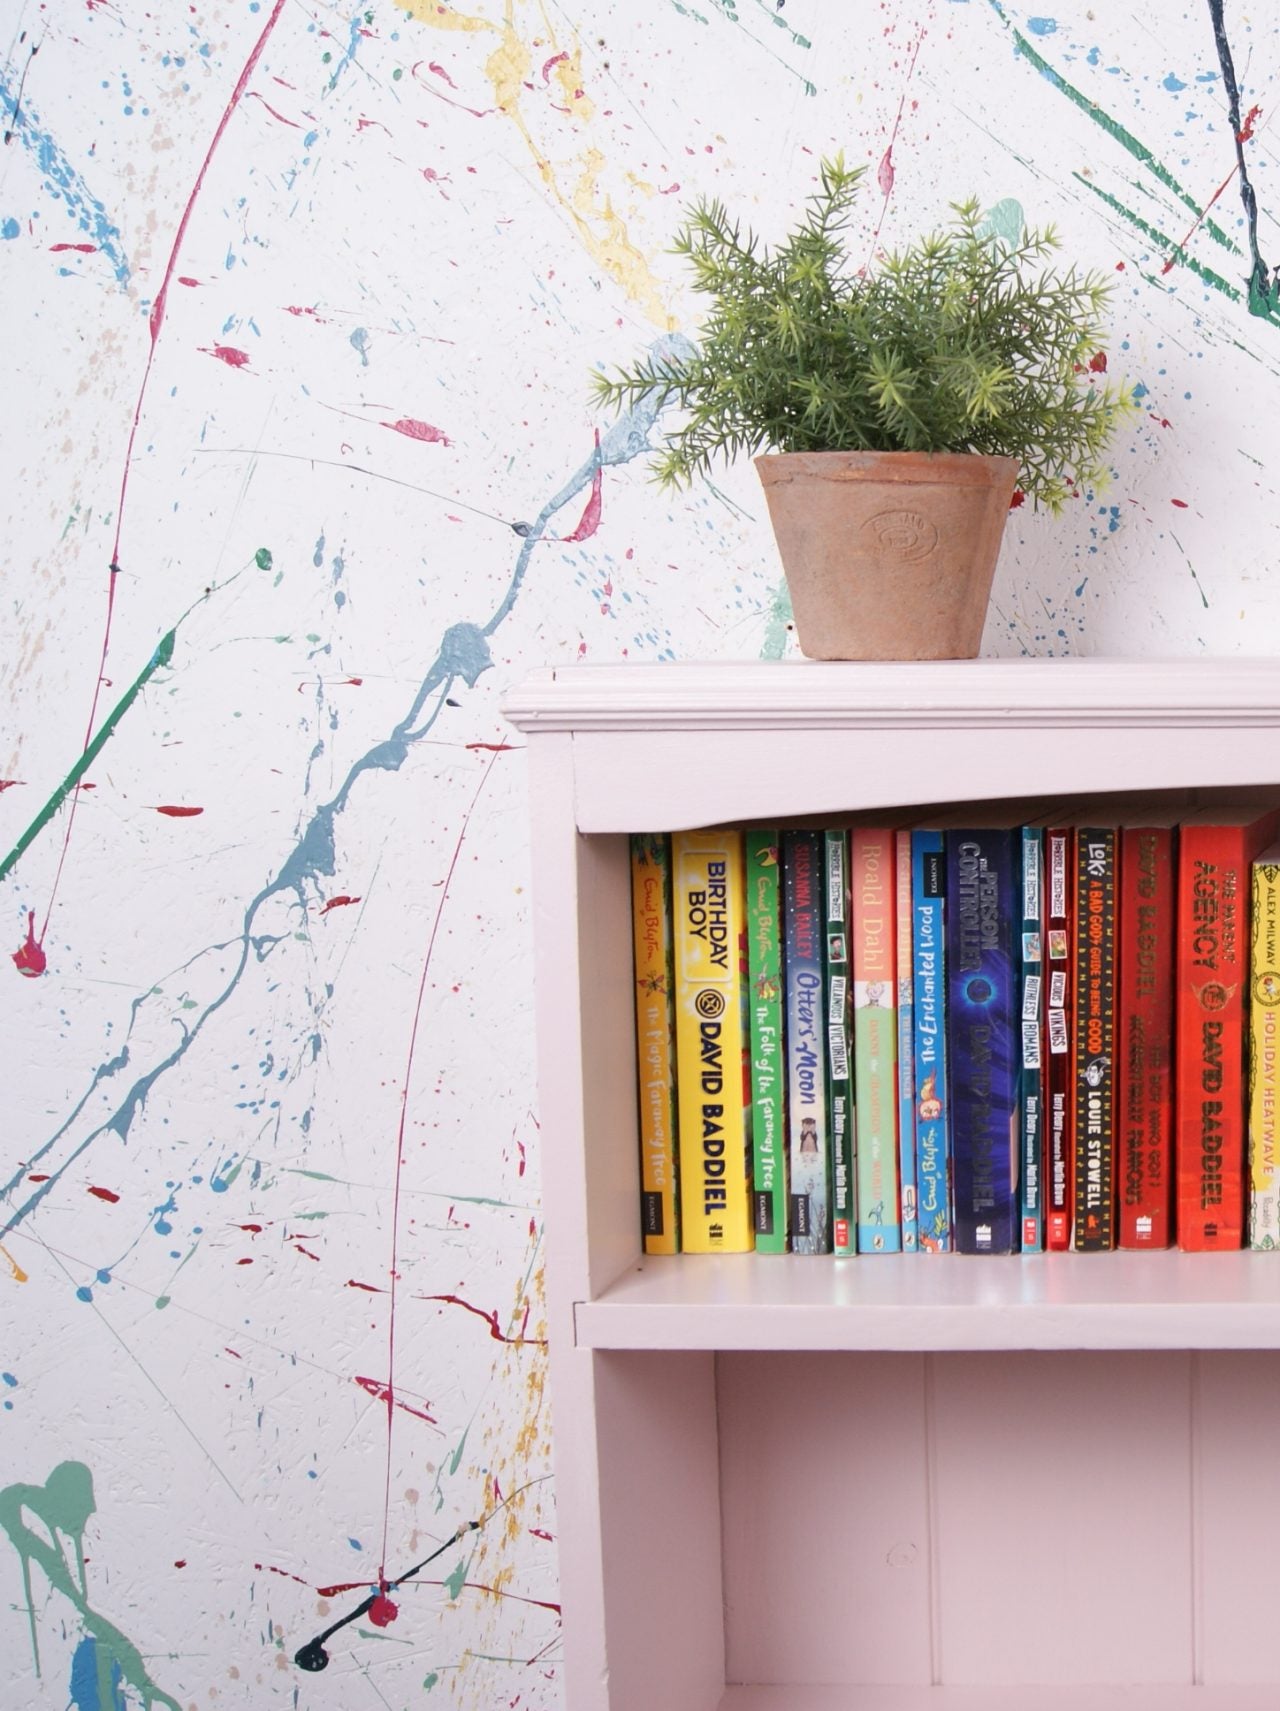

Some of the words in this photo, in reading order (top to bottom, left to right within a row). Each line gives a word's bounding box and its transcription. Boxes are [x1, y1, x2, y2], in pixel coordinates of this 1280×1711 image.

[793, 844, 811, 908] SUSANNA
[863, 845, 882, 905] Roald
[1138, 835, 1158, 899] DAVID
[1222, 869, 1237, 900] THE
[688, 890, 708, 941] BOY
[707, 861, 728, 970] BIRTHDAY
[959, 842, 981, 972] CONTROLLER
[980, 871, 999, 950] PERSON
[1089, 889, 1104, 914] BAD
[1193, 860, 1219, 971] AGENCY
[1266, 887, 1276, 916] ALEX
[794, 912, 813, 960] BAILEY
[863, 919, 883, 971] Dahl
[918, 906, 934, 947] Wood
[1136, 904, 1157, 997] BADDIEL
[1222, 905, 1236, 963] PARENT
[1266, 920, 1276, 965] MILWAY
[1089, 948, 1102, 976] GUIDE
[830, 978, 844, 1020] VILLAINOUS
[918, 952, 938, 1035] Enchanted
[1025, 979, 1038, 1016] RUTHLESS
[1051, 974, 1064, 1002] VICIOUS
[1090, 989, 1101, 1016] BEING
[756, 1007, 769, 1026] The
[1050, 1010, 1065, 1048] VIKINGS
[1088, 1018, 1103, 1054] GOOD
[646, 1029, 665, 1075] Magic
[699, 1022, 723, 1095] DAVID
[759, 1026, 775, 1057] Folk
[831, 1026, 847, 1076] VICTORIANS
[921, 1037, 936, 1064] The
[970, 1025, 992, 1096] DAVID
[1024, 1024, 1039, 1068] ROMANS
[1202, 1021, 1223, 1093] DAVID
[1264, 1012, 1276, 1084] HOLIDAY
[755, 1058, 774, 1075] of
[759, 1076, 775, 1094] the
[795, 1042, 819, 1105] Moon
[647, 1081, 667, 1148] Faraway
[757, 1096, 775, 1154] Faraway
[1088, 1092, 1102, 1134] LOUIE
[1263, 1088, 1276, 1174] HEATWAVE
[651, 1152, 668, 1186] Tree
[701, 1104, 727, 1216] BADDIEL
[760, 1155, 776, 1189] Tree
[922, 1128, 940, 1176] Blyton
[973, 1103, 994, 1212] BADDIEL
[1087, 1141, 1101, 1208] STOWELL
[1125, 1129, 1144, 1206] FAMOUS
[1201, 1101, 1223, 1210] BADDIEL
[759, 1195, 768, 1230] EGMONT
[798, 1197, 806, 1233] EGMONT
[923, 1175, 938, 1211] Enid
